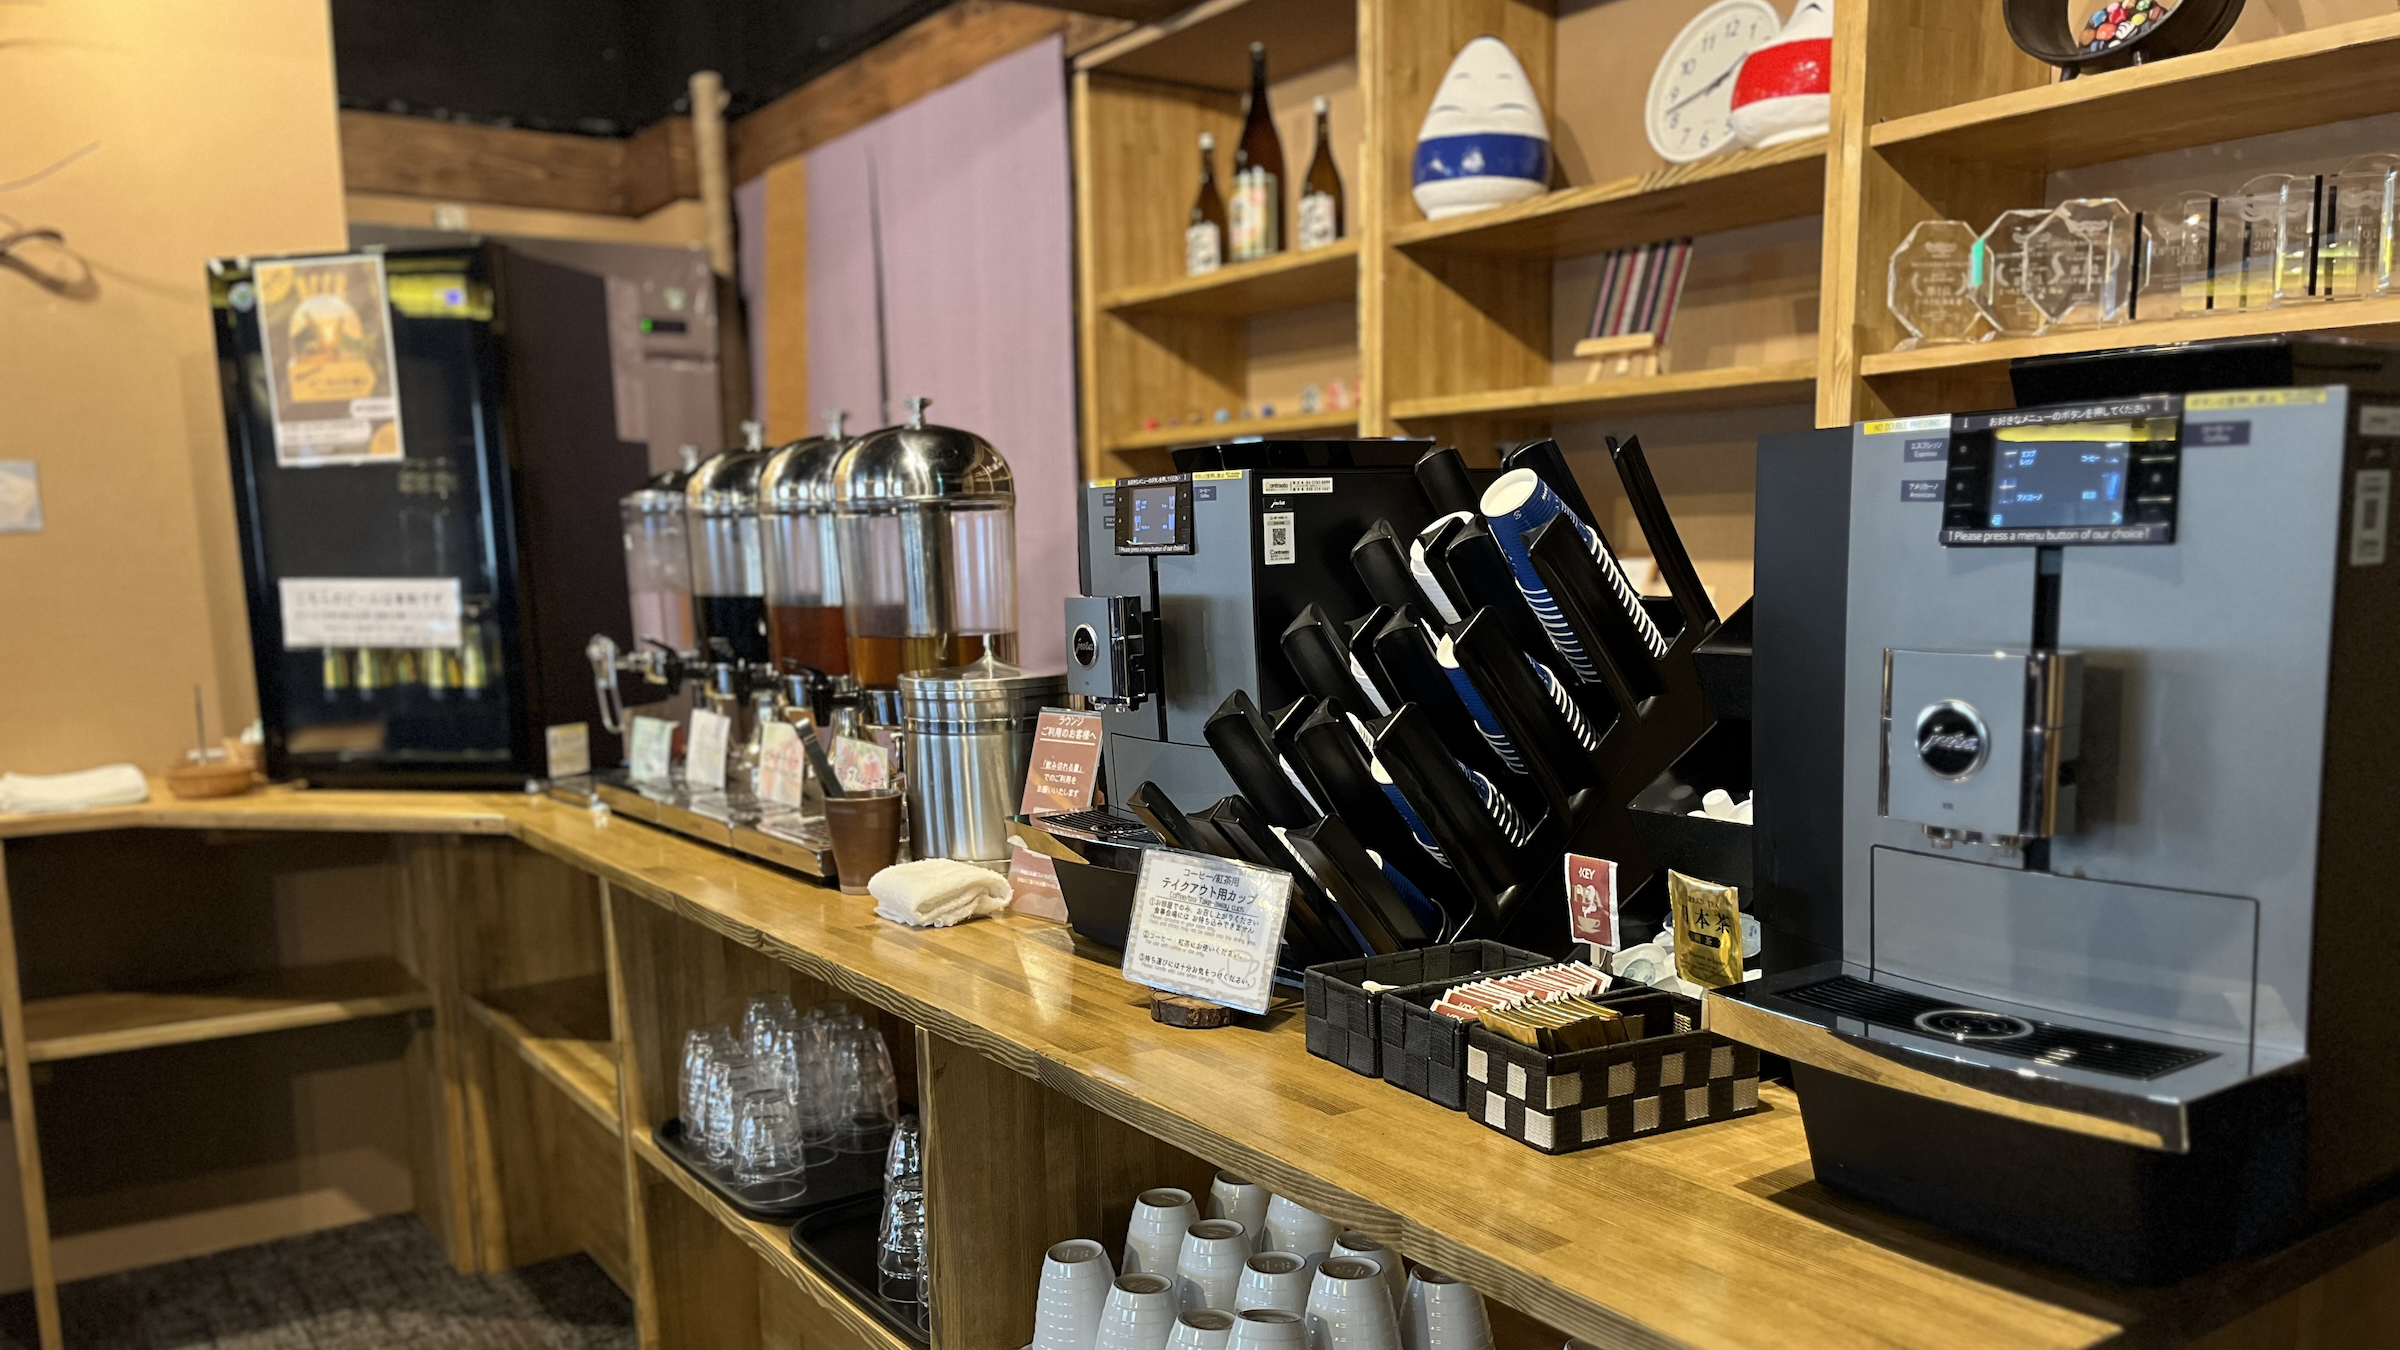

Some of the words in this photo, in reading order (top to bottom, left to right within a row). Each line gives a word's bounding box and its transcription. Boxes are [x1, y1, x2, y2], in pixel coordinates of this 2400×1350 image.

[1725, 17, 1740, 38] 12
[1702, 34, 1716, 52] 11
[1682, 58, 1696, 76] 10
[1989, 405, 2150, 427] お好きなメニューのボタンを押してください
[1954, 531, 1983, 541] Please
[1984, 532, 2008, 543] press
[2017, 532, 2045, 540] menu
[2046, 530, 2078, 540] button
[2080, 529, 2092, 539] of
[2093, 531, 2108, 539] our
[2112, 528, 2144, 539] choice
[1059, 716, 1084, 727] ラウンジ
[1041, 726, 1096, 740] ご利用のお客様へ
[1920, 726, 1978, 754] jura
[1044, 774, 1077, 785] でのご利用を
[1182, 868, 1240, 887] コーヒー/紅茶用
[1578, 866, 1596, 880] KEY
